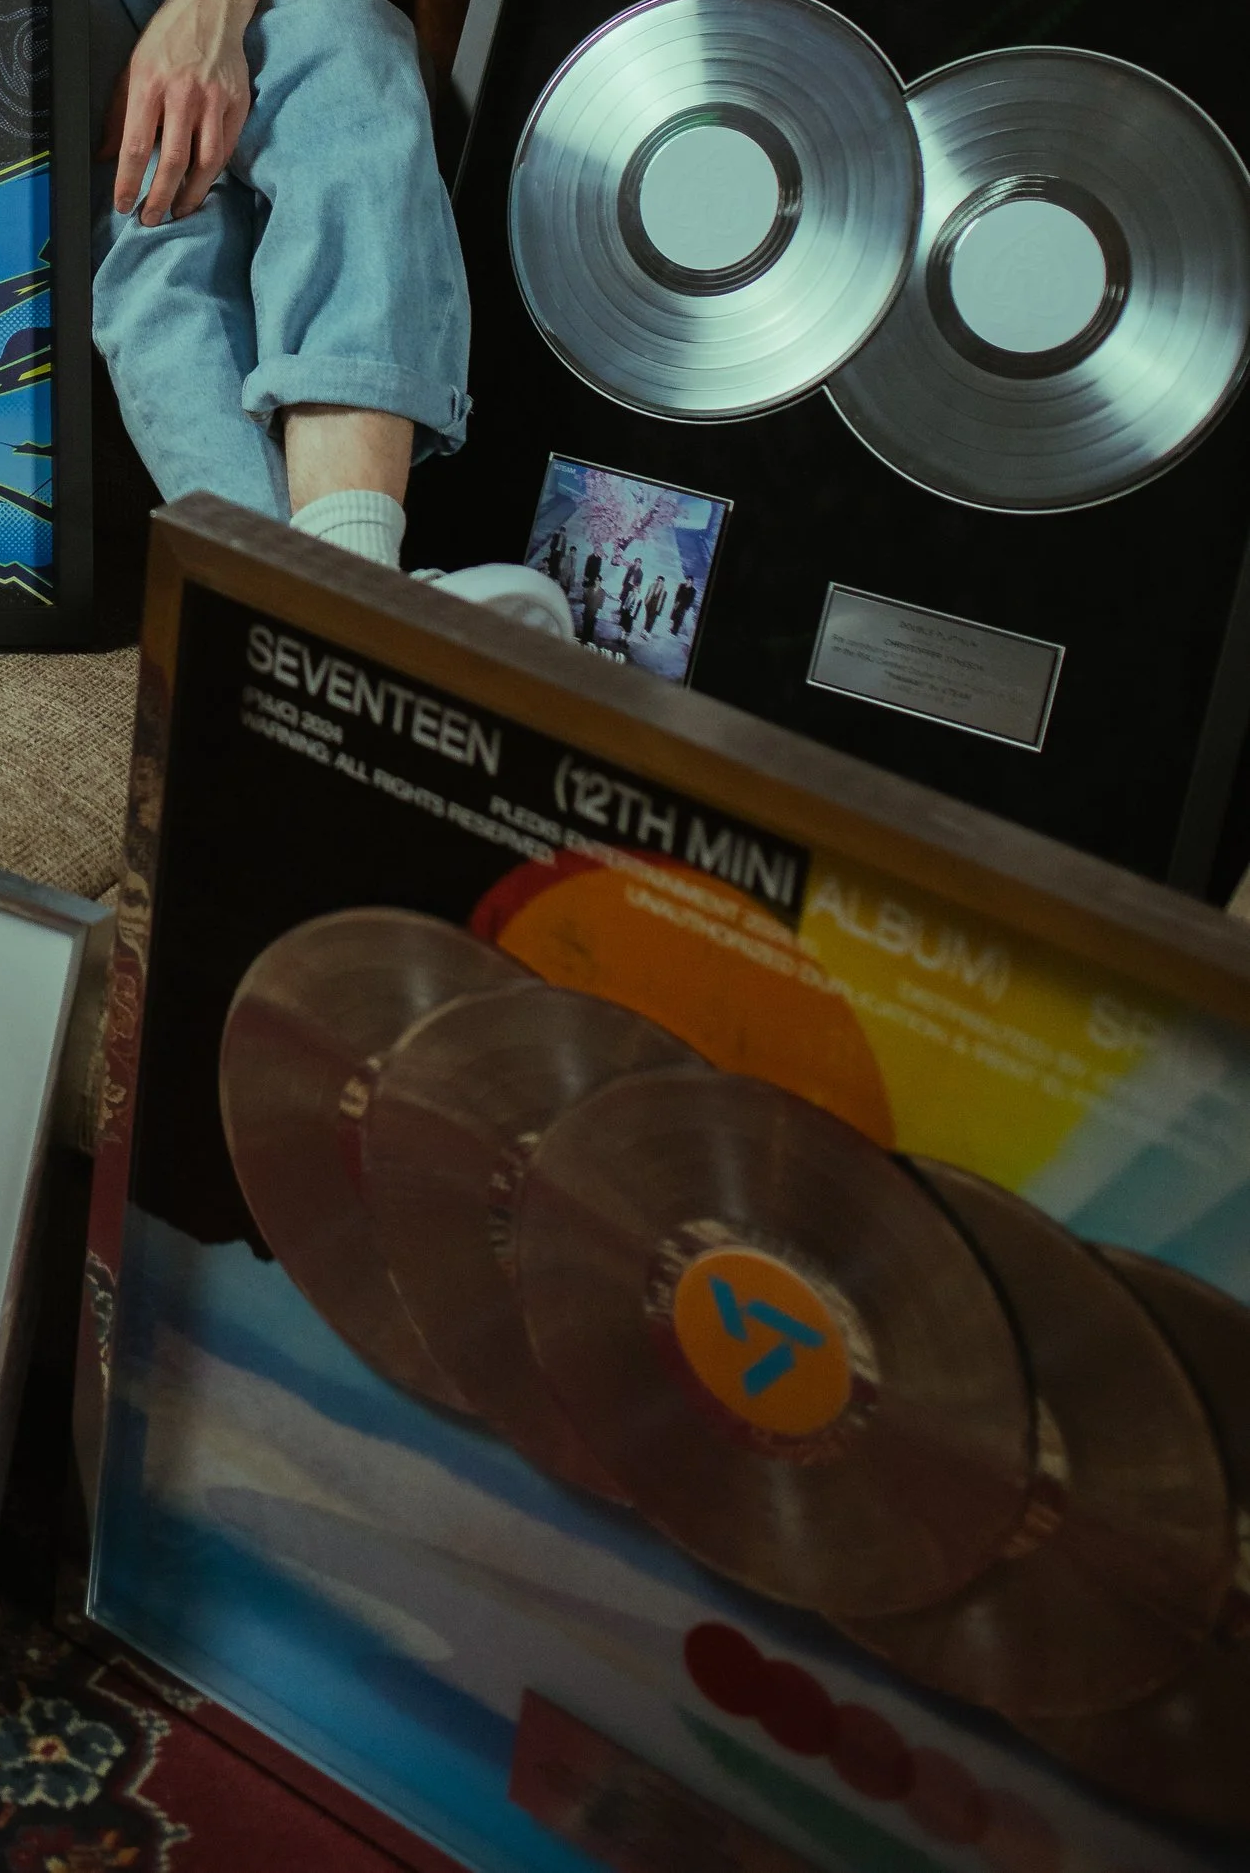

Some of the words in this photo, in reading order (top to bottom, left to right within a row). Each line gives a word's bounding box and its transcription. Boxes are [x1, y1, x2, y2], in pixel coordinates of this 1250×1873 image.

[246, 621, 504, 778] SEVENTEEN
[554, 754, 678, 853] (12TH
[684, 815, 798, 907] MINI
[334, 751, 371, 786] ALL
[372, 768, 445, 820] RIGHTS
[446, 801, 557, 866] RESERVED
[489, 794, 562, 845] PLEDIS
